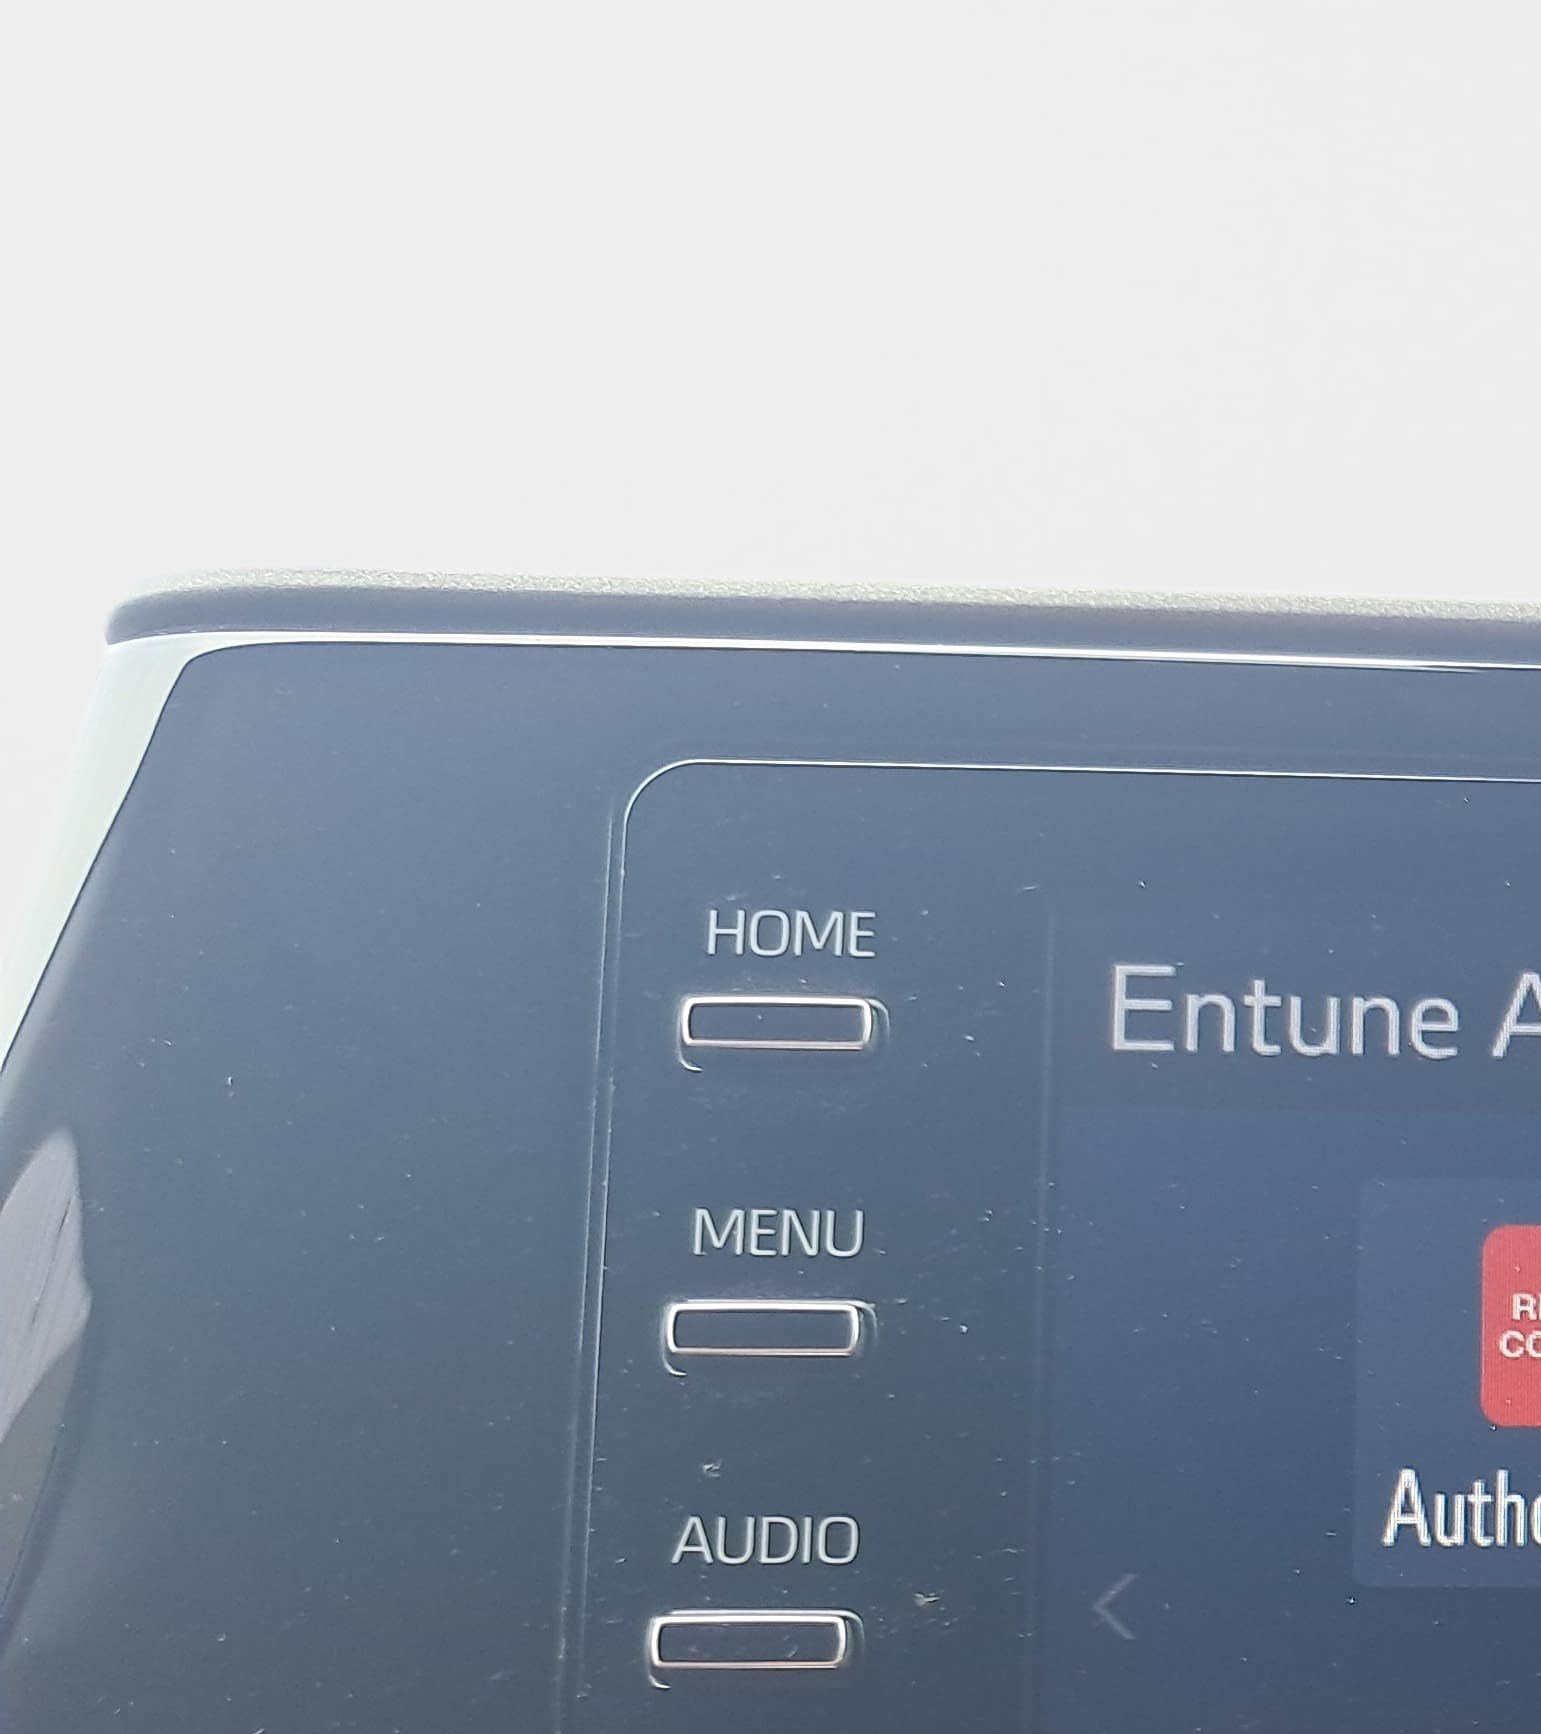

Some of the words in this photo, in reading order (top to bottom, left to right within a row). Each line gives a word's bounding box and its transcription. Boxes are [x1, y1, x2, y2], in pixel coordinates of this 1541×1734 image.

[708, 910, 874, 956] HOME
[1113, 964, 1458, 1058] Entune
[694, 1209, 862, 1256] MENU
[672, 1517, 857, 1563] AUDIO
